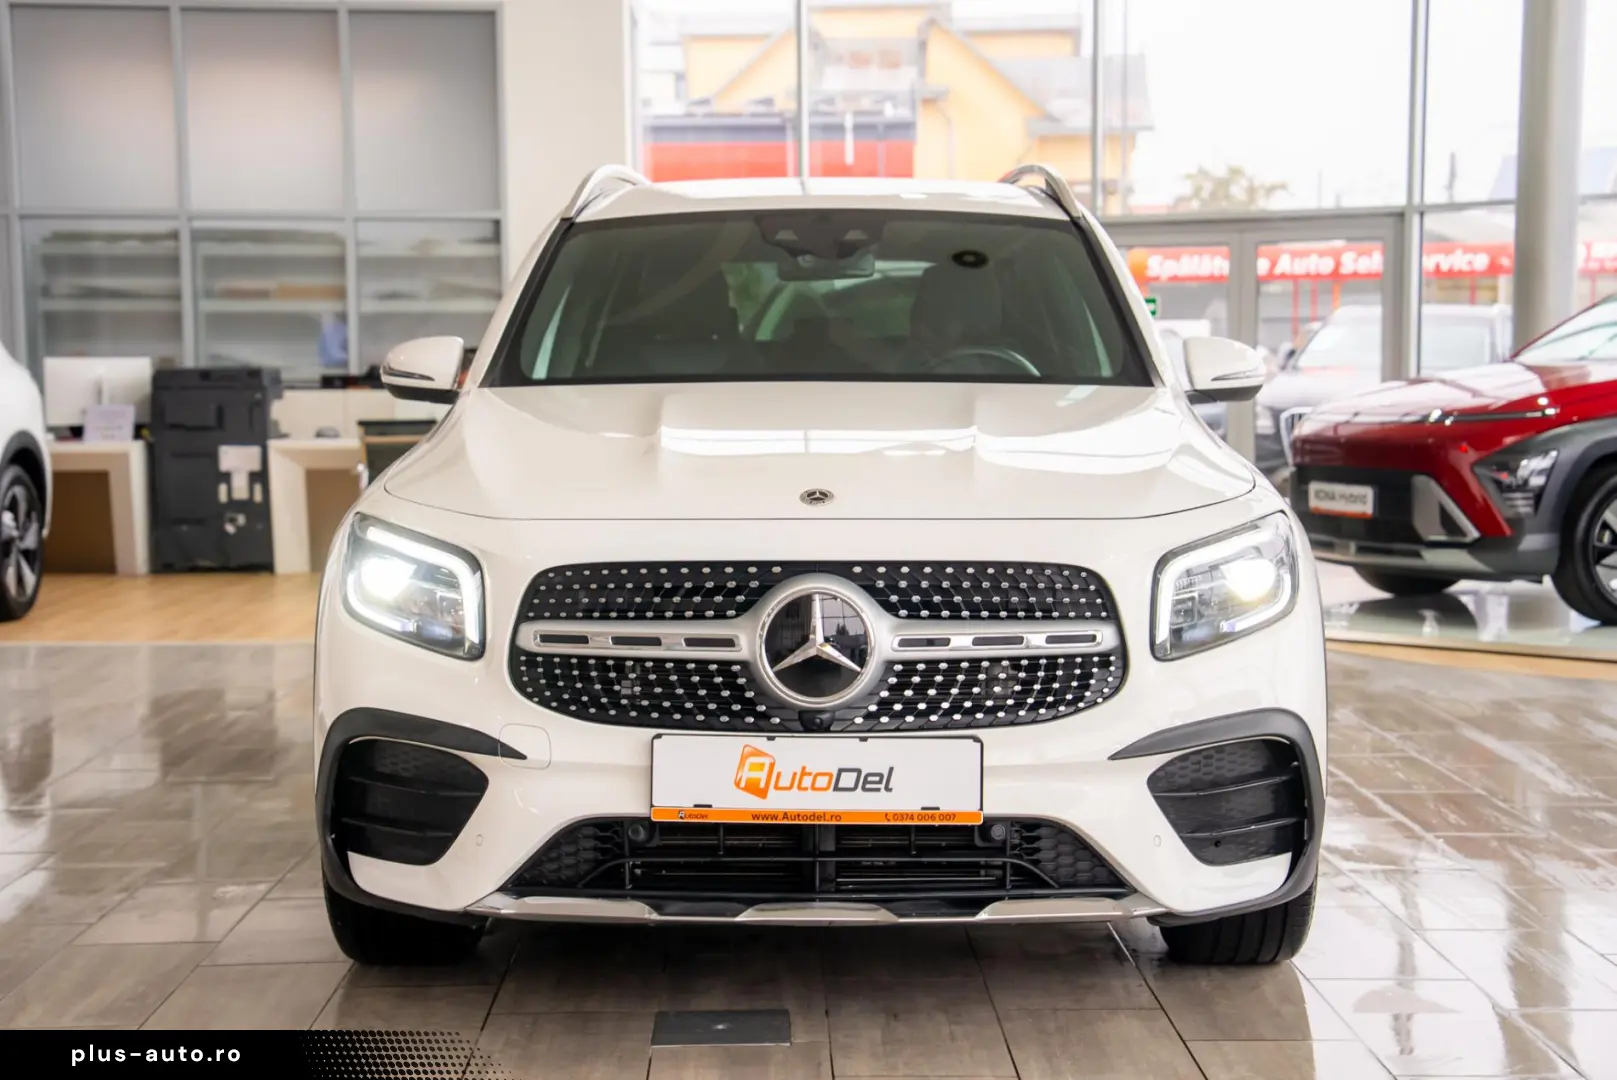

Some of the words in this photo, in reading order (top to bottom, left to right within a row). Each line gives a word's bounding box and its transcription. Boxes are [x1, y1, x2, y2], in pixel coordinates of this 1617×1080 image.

[1273, 253, 1335, 276] Auto
[1339, 250, 1384, 275] Sel
[738, 754, 894, 793] AutoDel
[751, 811, 842, 822] www.Autodel.ro
[892, 813, 915, 822] 0374
[916, 813, 937, 822] 006
[938, 813, 957, 822] 007
